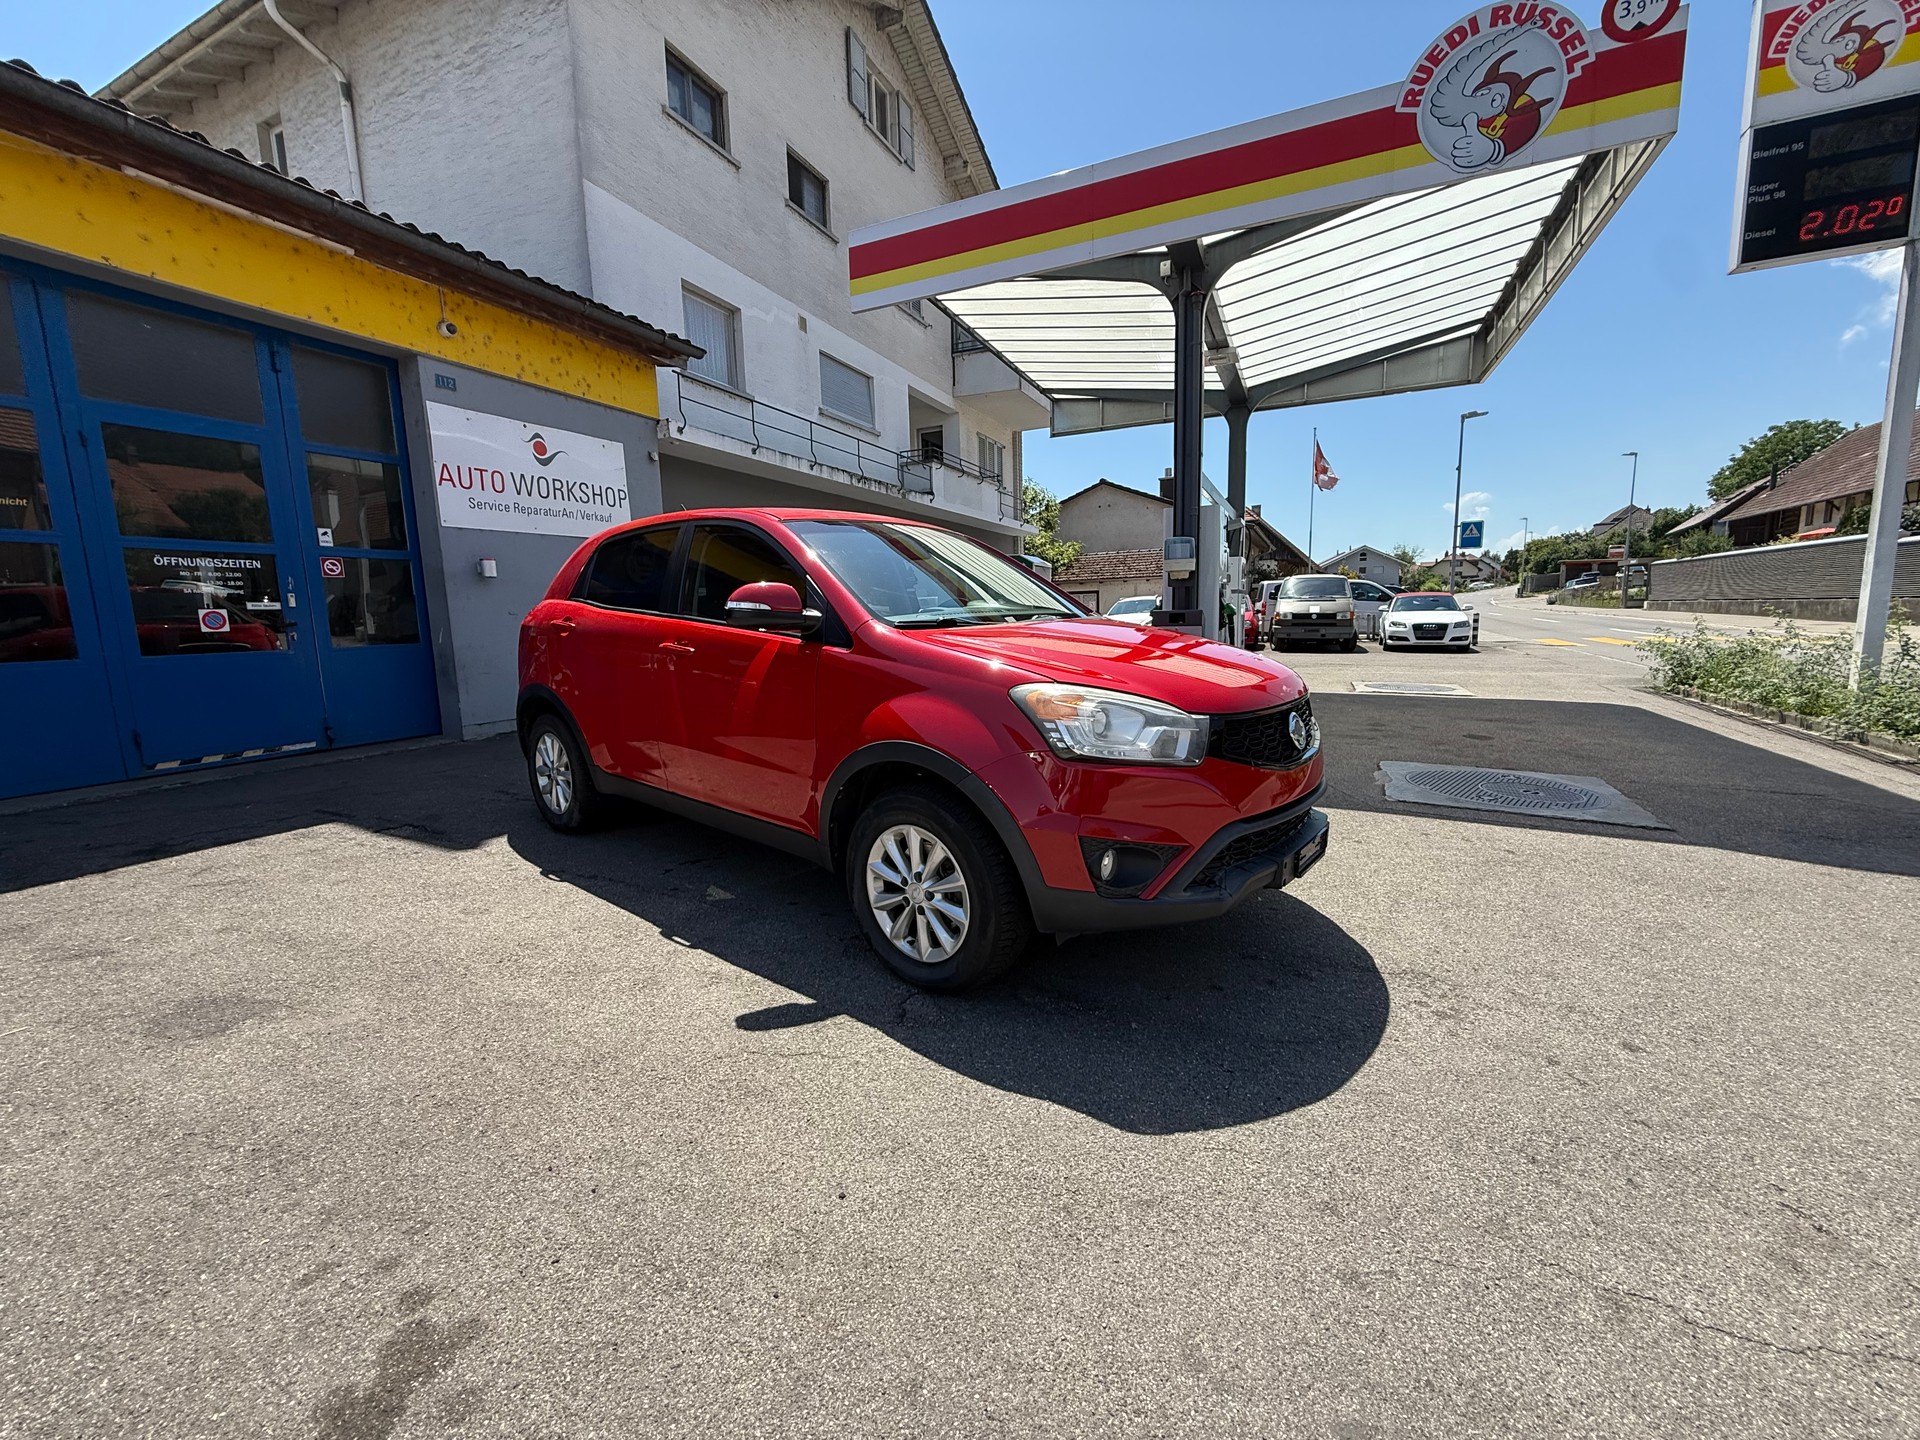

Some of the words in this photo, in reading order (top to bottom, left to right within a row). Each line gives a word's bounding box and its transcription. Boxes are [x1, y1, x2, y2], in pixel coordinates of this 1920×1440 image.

[1619, 0, 1647, 19] 3,9
[1772, 0, 1836, 55] RUED
[1401, 15, 1480, 108] RUEDI
[1489, 0, 1590, 75] RÜSSEL
[1752, 144, 1789, 160] Bleifrei
[1791, 141, 1805, 151] 95
[1749, 181, 1780, 194] Super
[1748, 193, 1771, 204] Plus
[1772, 190, 1786, 200] 98
[1744, 227, 1777, 240] Diesel
[438, 375, 454, 390] 112
[438, 463, 506, 494] AUTO
[510, 471, 628, 509] WORKSHOP
[468, 496, 511, 514] Service
[153, 554, 261, 569] ÖFFNUNGSZEITEN
